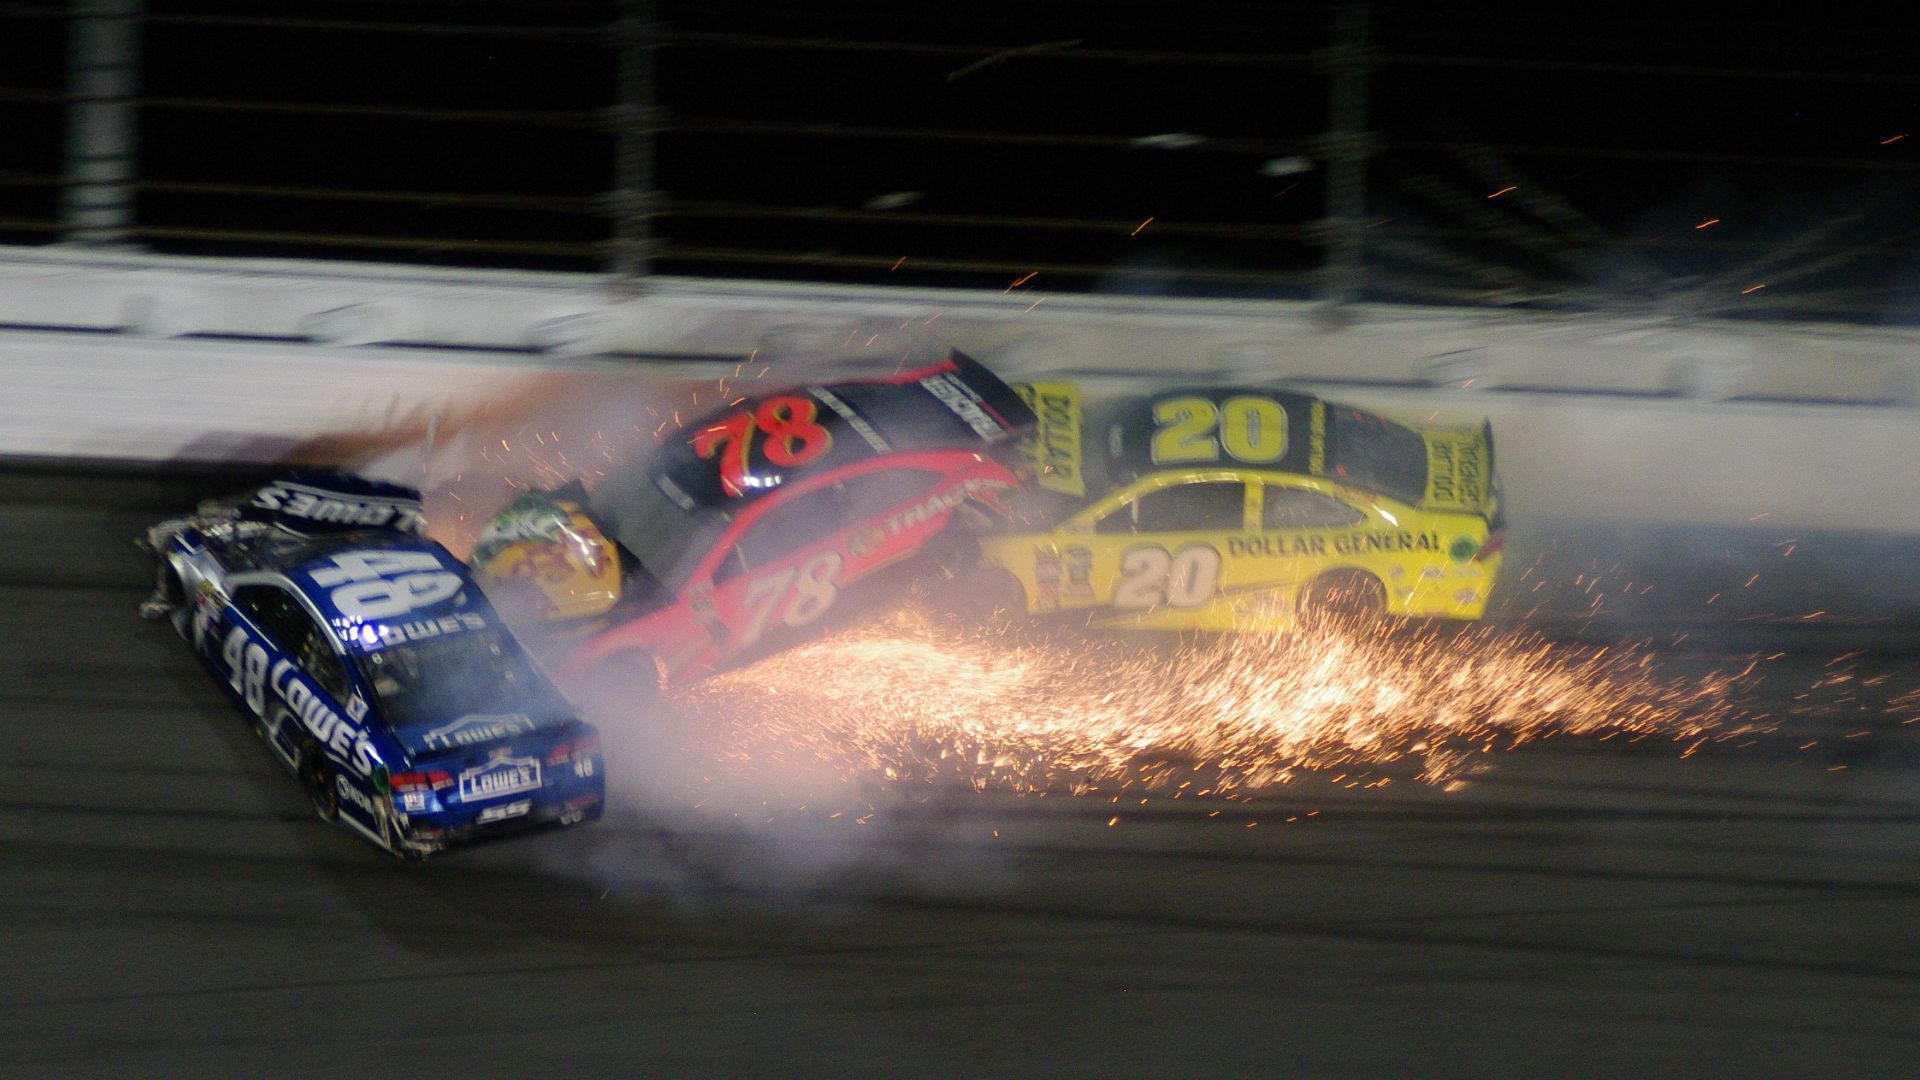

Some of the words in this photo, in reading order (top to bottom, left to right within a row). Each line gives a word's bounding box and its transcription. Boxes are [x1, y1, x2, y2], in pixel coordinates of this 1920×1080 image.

[694, 395, 834, 498] 78
[1152, 395, 1290, 465] 20
[1432, 441, 1455, 499] DOLLAR
[1458, 435, 1481, 506] GENERAL
[1112, 541, 1223, 608] 20
[1228, 535, 1327, 558] DOLLAR
[1333, 530, 1446, 555] GENERAL
[308, 550, 463, 621] 48
[740, 551, 844, 645] 78
[223, 625, 269, 717] 48
[271, 658, 374, 777] LOWE'S
[471, 765, 531, 795] LOWE'S
